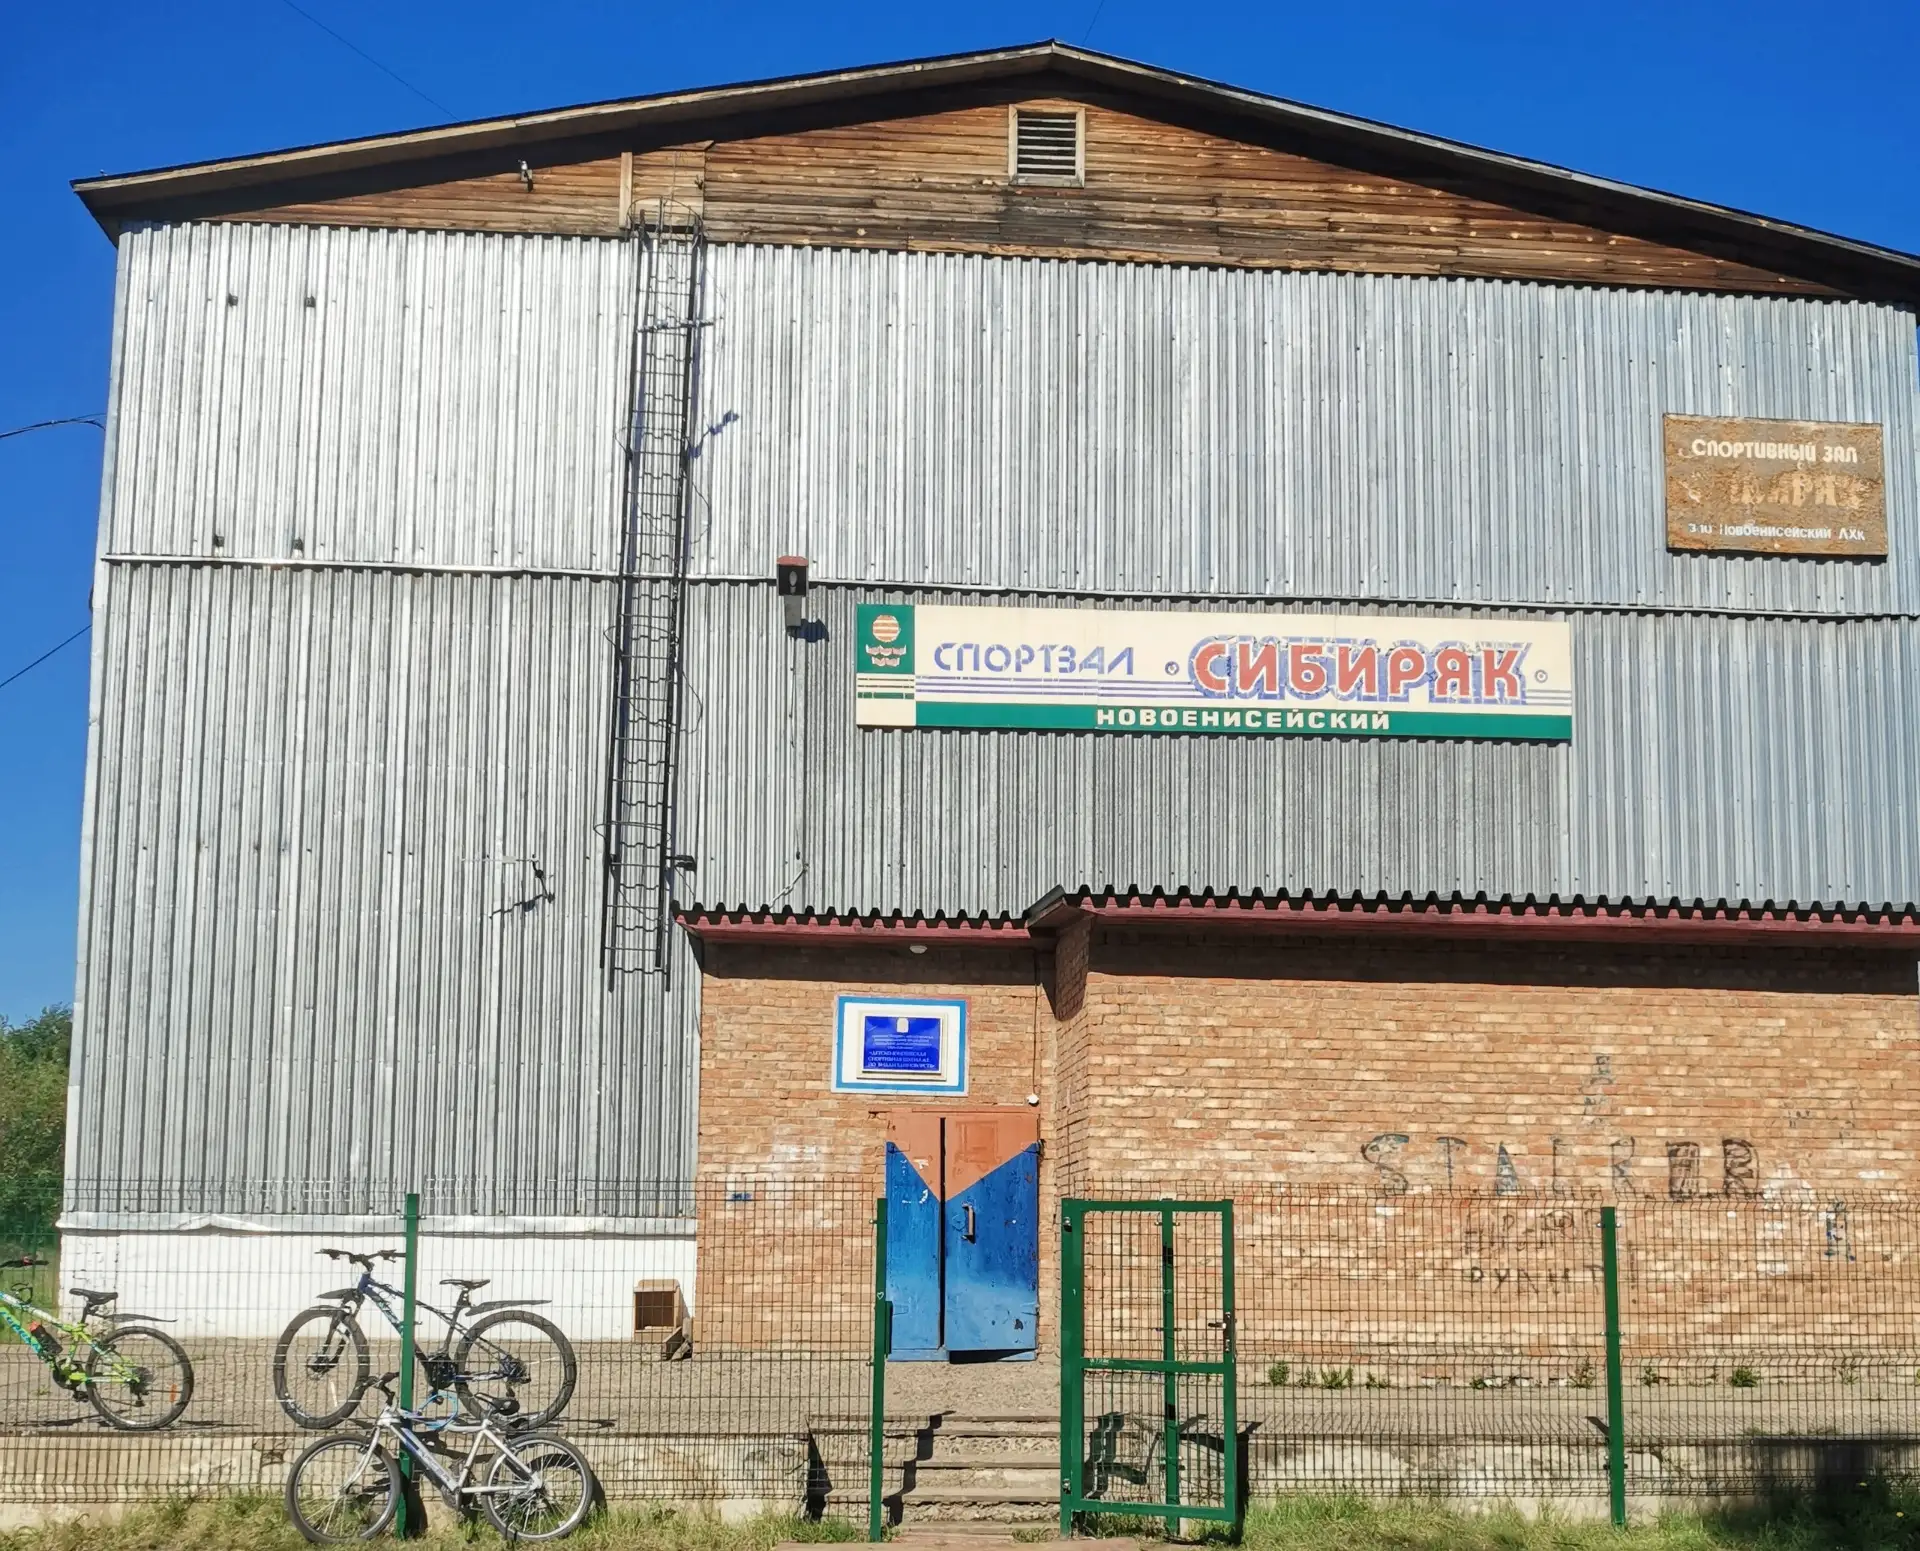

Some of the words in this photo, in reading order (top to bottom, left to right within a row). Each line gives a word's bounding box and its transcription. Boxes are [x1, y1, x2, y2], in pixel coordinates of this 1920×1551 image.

[933, 642, 1135, 676] СПОРТЗАЛ
[1189, 637, 1529, 703] СИБИРЯК
[1096, 708, 1391, 730] НОВОЕНИСЕЙСКИЙ
